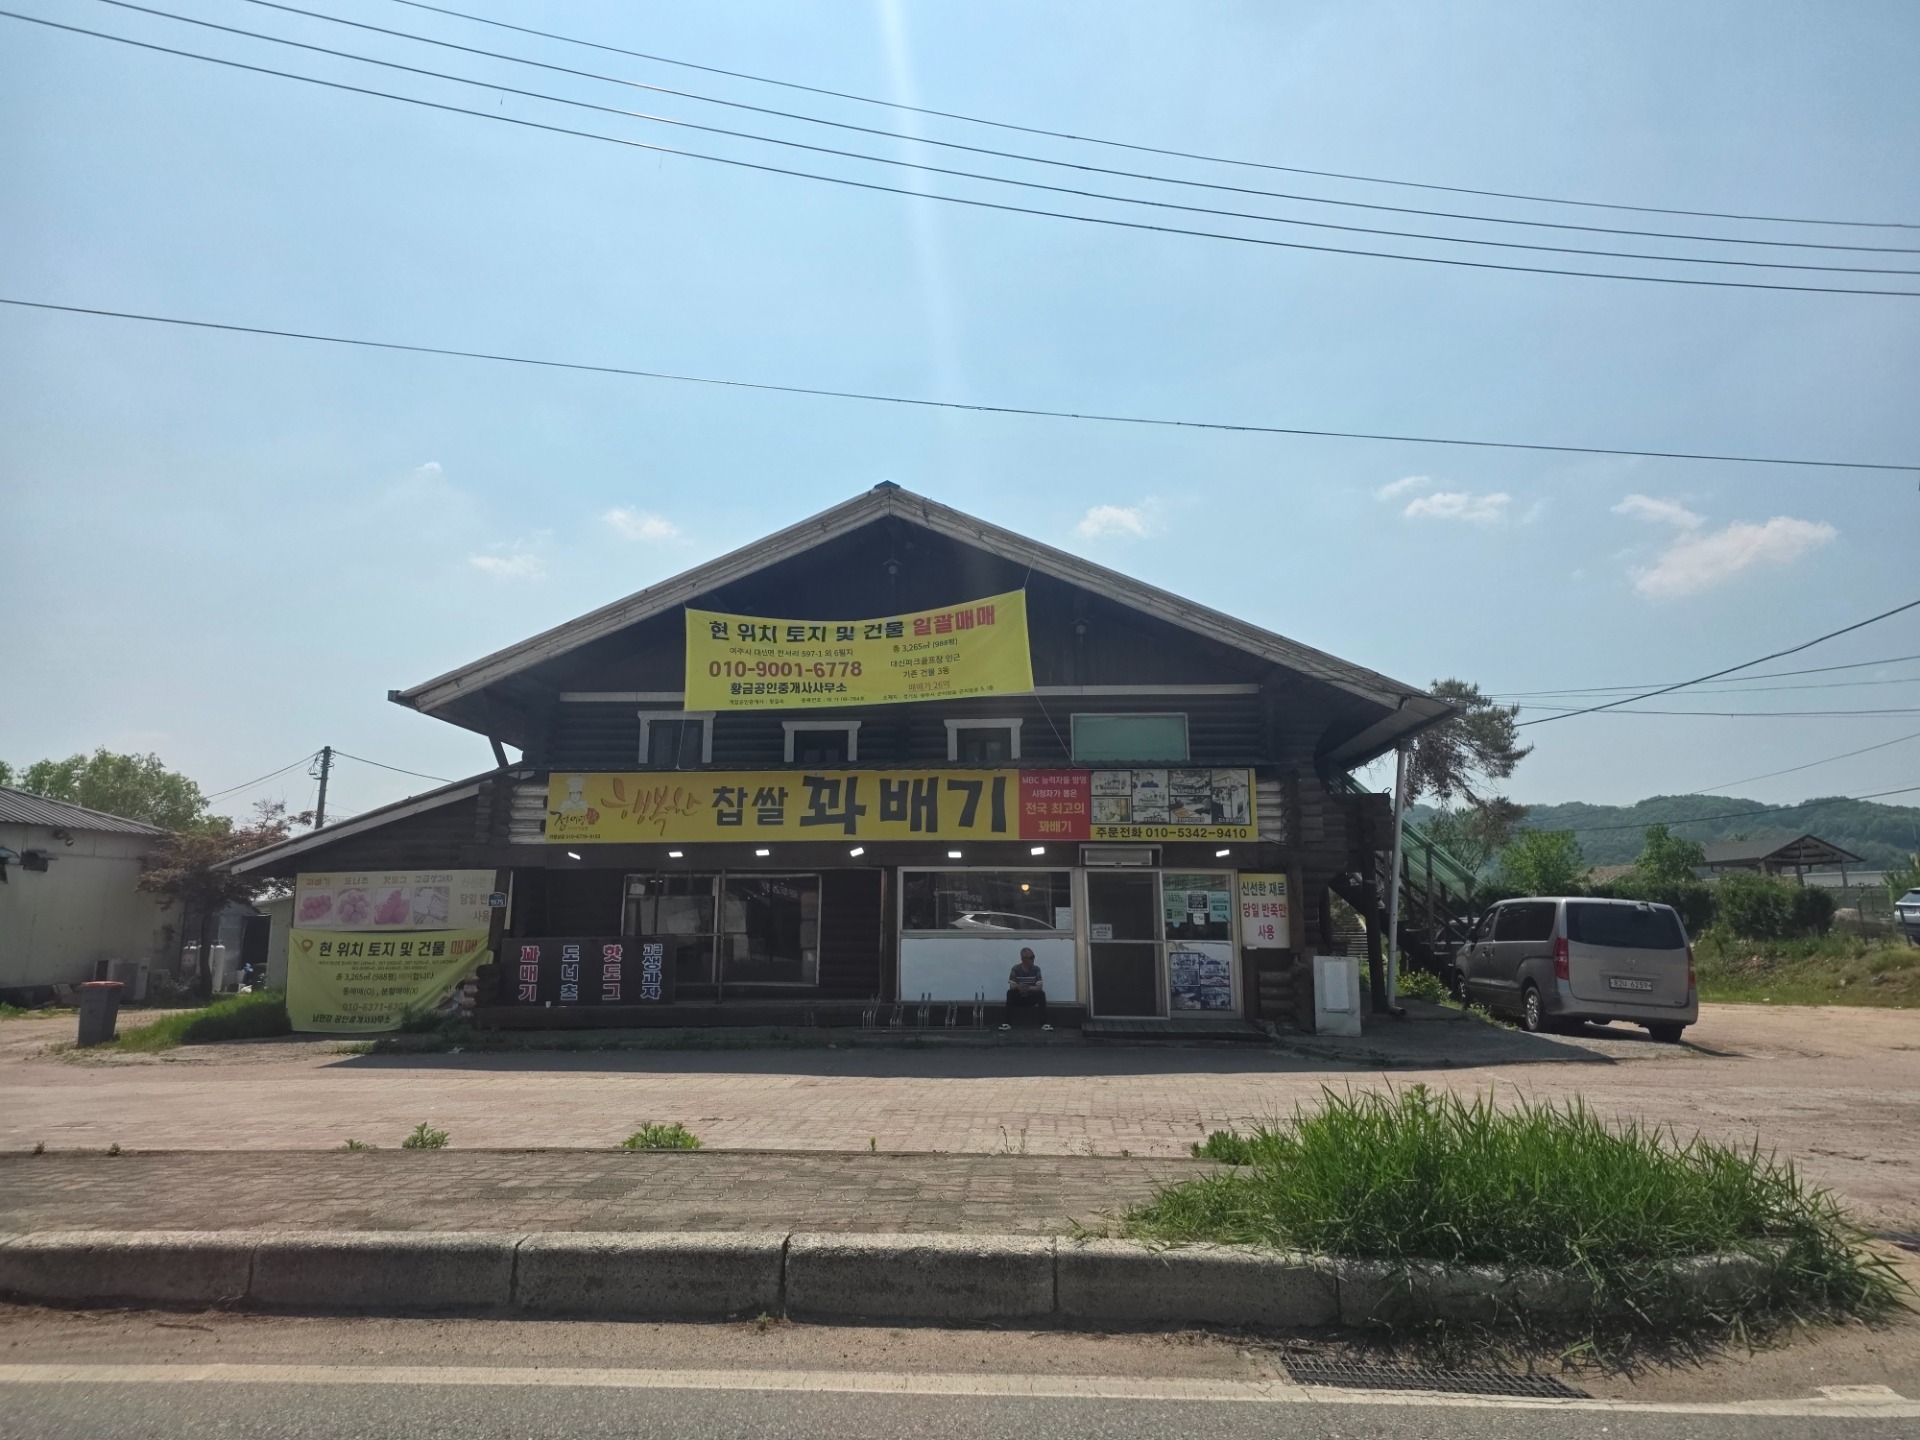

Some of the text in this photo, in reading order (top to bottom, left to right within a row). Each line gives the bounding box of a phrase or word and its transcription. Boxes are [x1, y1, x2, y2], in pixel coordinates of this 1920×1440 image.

[709, 605, 995, 644] 현 위치 토지 및 건물 일괄매매
[729, 648, 752, 656] 여주시
[802, 650, 822, 658] 597-1
[708, 660, 862, 678] 010-9001-6778
[902, 670, 918, 678] 기존
[920, 668, 935, 677] 건물
[730, 682, 848, 695] 황금공인중개사사무소
[1022, 776, 1040, 784] MBC
[1032, 790, 1060, 798] 시청자가
[711, 786, 789, 826] 찹쌀
[800, 776, 1006, 835] 꽈배기
[1025, 802, 1085, 815] 전국 최고의
[1038, 820, 1072, 833] 꽈배기
[1096, 826, 1247, 839] 주문전화 010-5342-9410
[1241, 880, 1286, 896] 신선한 재료
[1242, 902, 1260, 918] 당일
[1262, 902, 1287, 918] 반죽만
[1258, 924, 1275, 940] 사용
[319, 941, 331, 957] 현
[336, 942, 364, 958] 위치
[367, 942, 396, 958] 토지
[400, 942, 414, 957] 및
[418, 940, 446, 957] 건물
[518, 945, 540, 1002] 꽈배기
[560, 944, 580, 1001] 도너츠
[602, 944, 623, 1000] 핫도그
[640, 943, 663, 1000] 고급생과자
